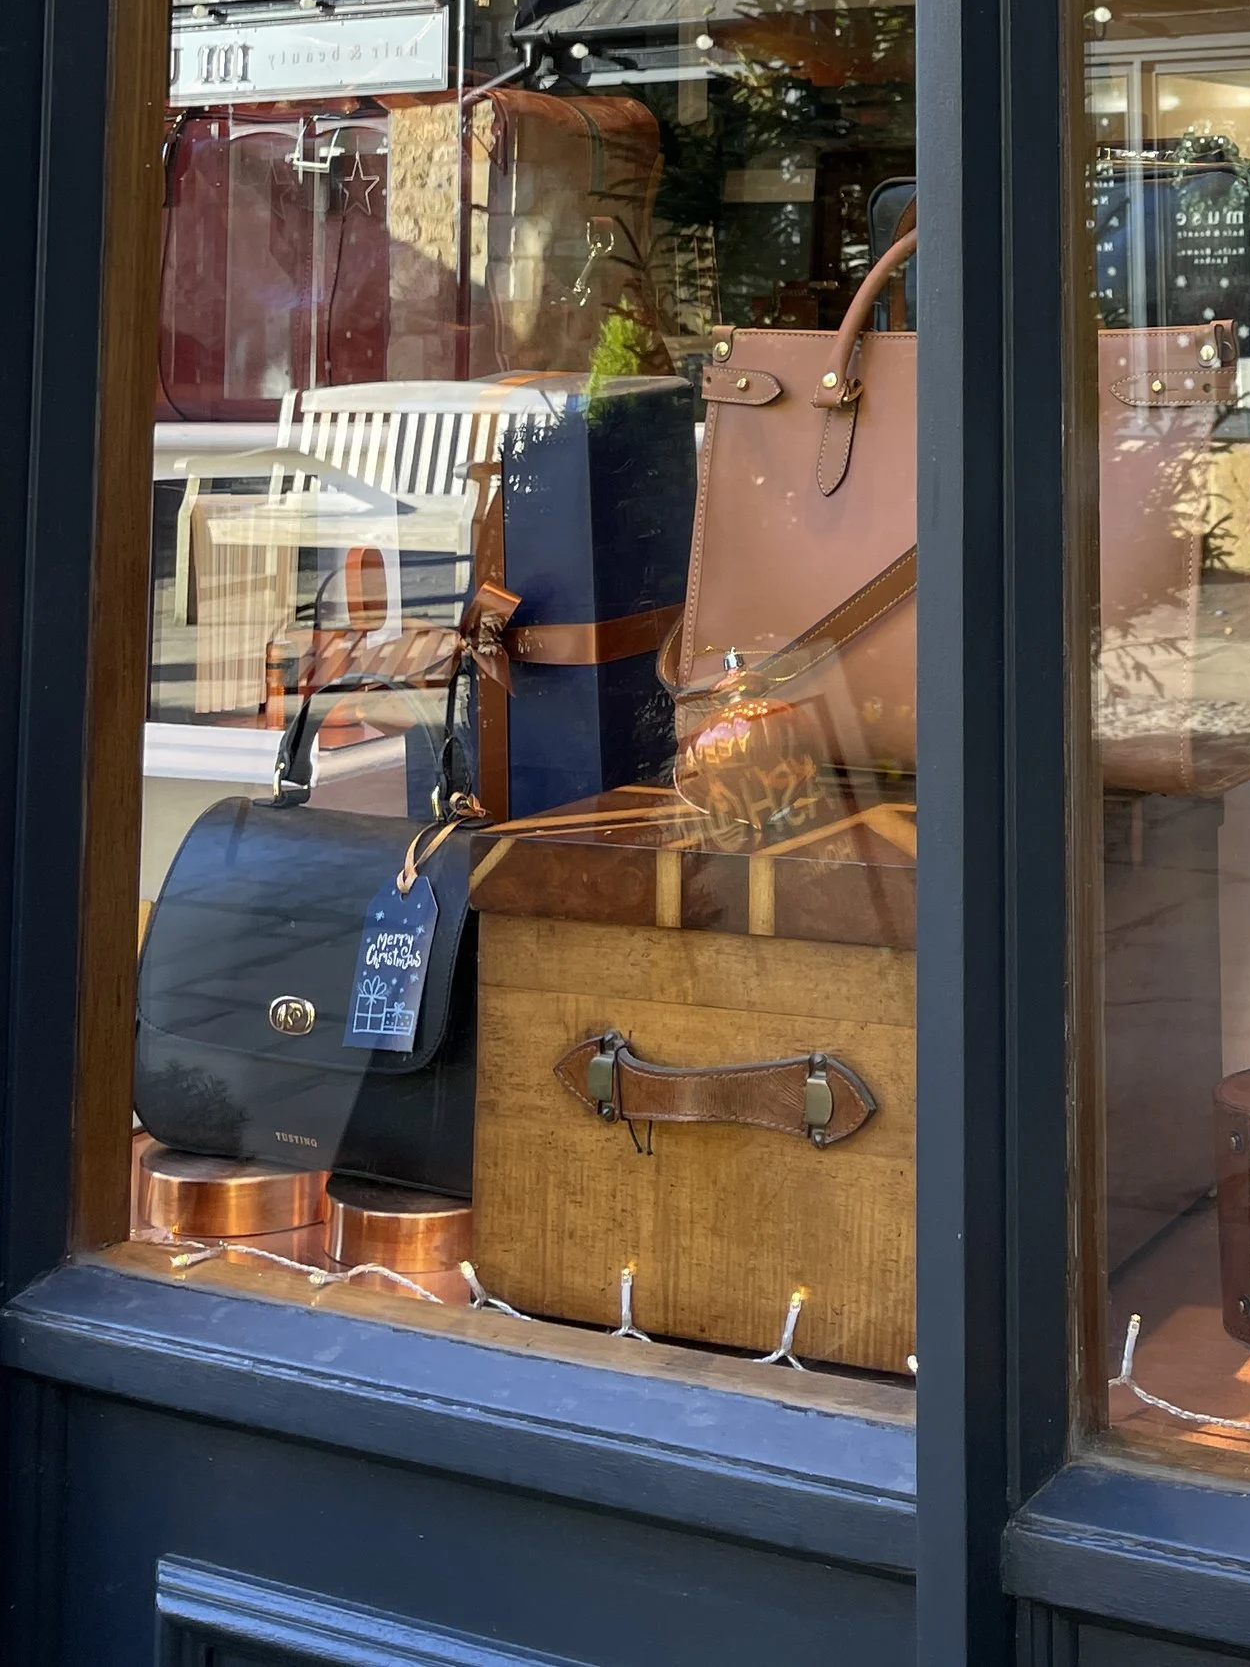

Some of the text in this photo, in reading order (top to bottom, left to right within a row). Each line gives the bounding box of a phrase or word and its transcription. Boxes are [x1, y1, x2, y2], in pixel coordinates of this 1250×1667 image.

[376, 932, 414, 952] Merry
[365, 942, 422, 970] Christmas
[274, 1131, 318, 1148] TUSTING
